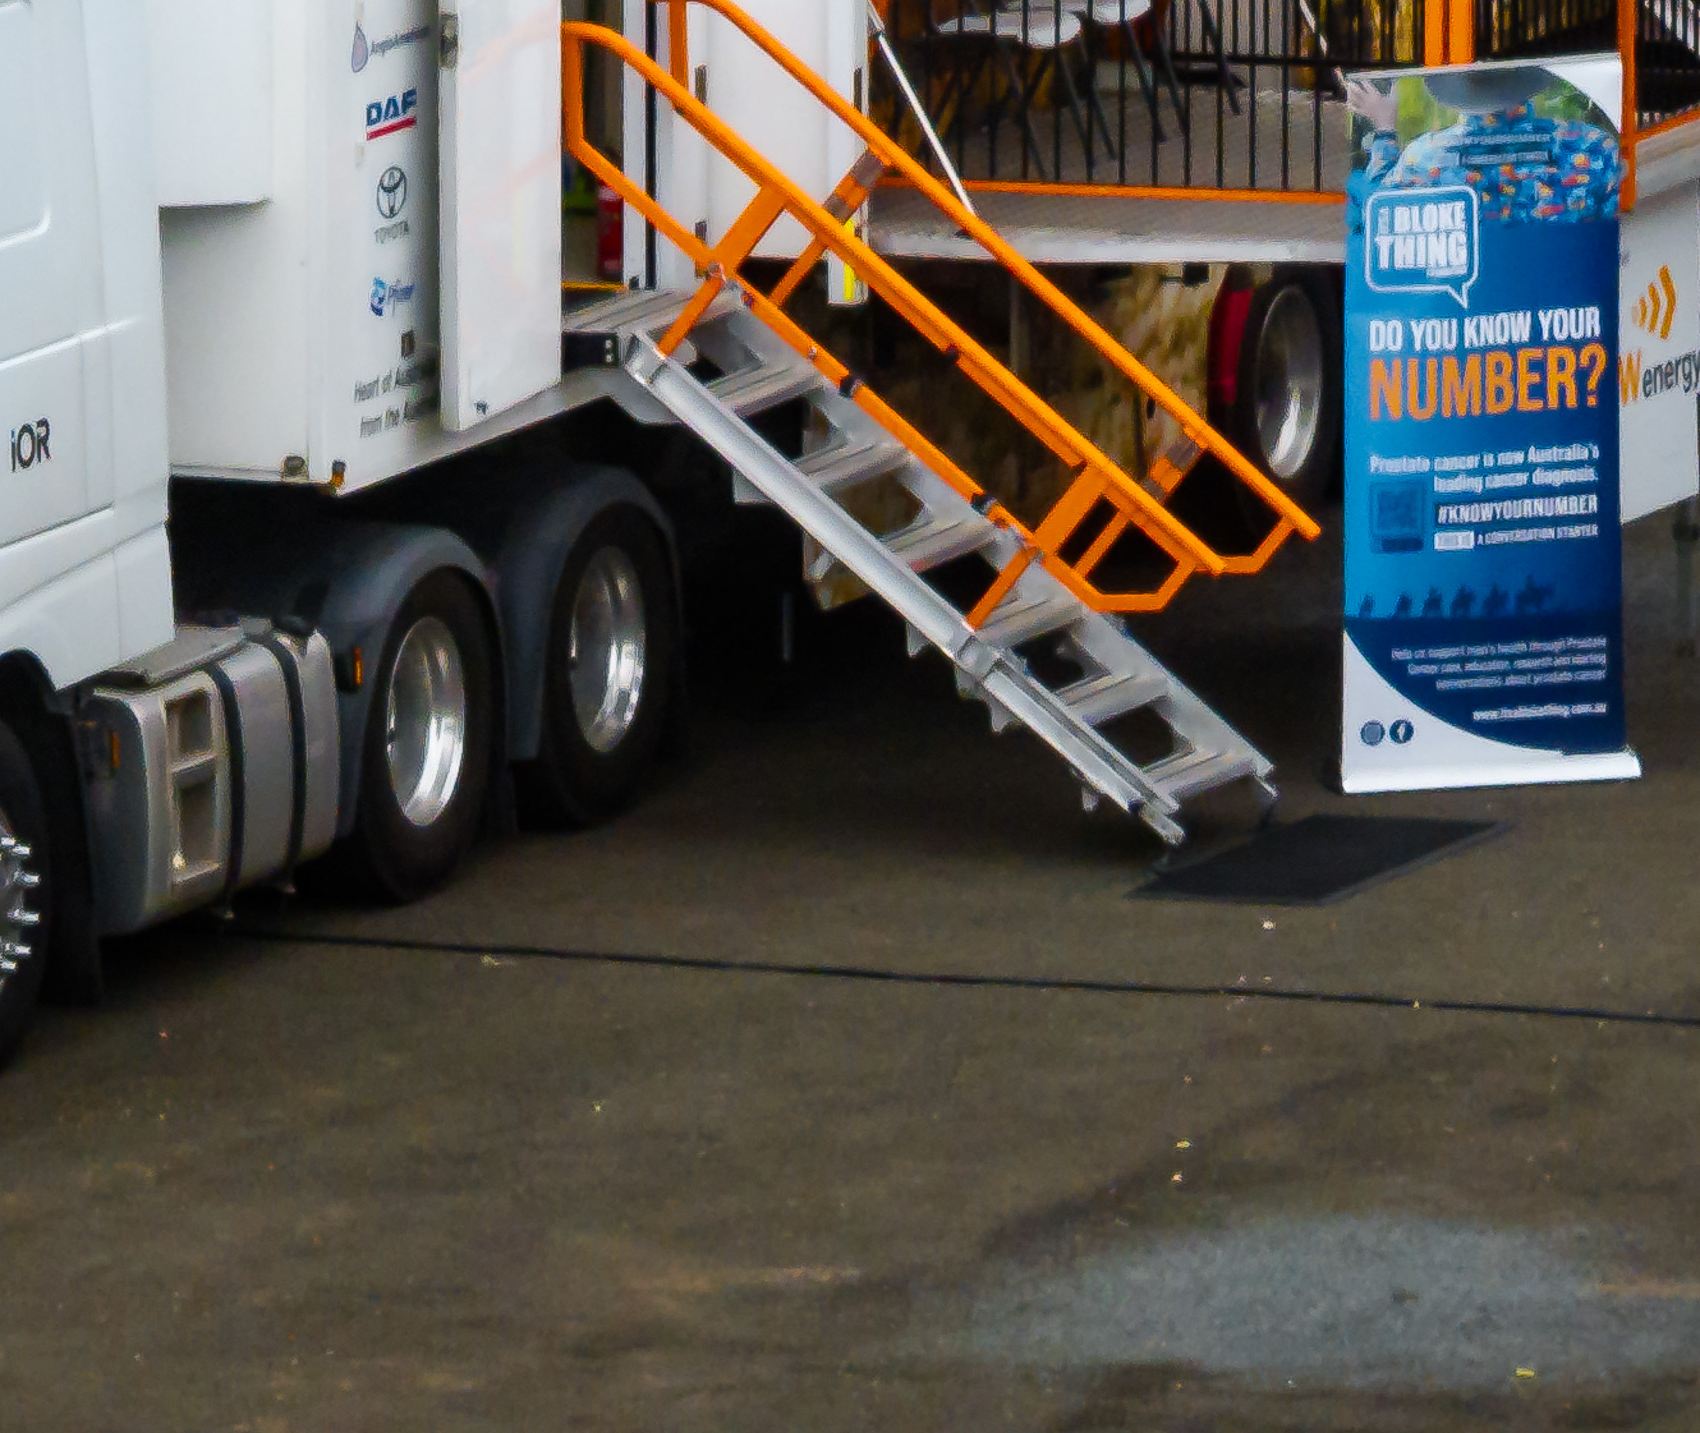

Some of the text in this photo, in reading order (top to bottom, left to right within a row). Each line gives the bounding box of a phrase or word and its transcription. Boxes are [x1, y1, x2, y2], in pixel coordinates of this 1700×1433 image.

[366, 87, 417, 127] DAF
[1393, 200, 1467, 233] BLOKE
[1374, 229, 1468, 271] THING
[1369, 306, 1601, 352] DO YOU KNOW YOUR
[1368, 342, 1608, 422] NUMBER?
[1369, 443, 1600, 474] Prostate cancer is now Australia's
[1433, 473, 1484, 494] leading
[1484, 471, 1530, 489] cancer
[1437, 493, 1598, 525] #KNOWYOURNUMBER
